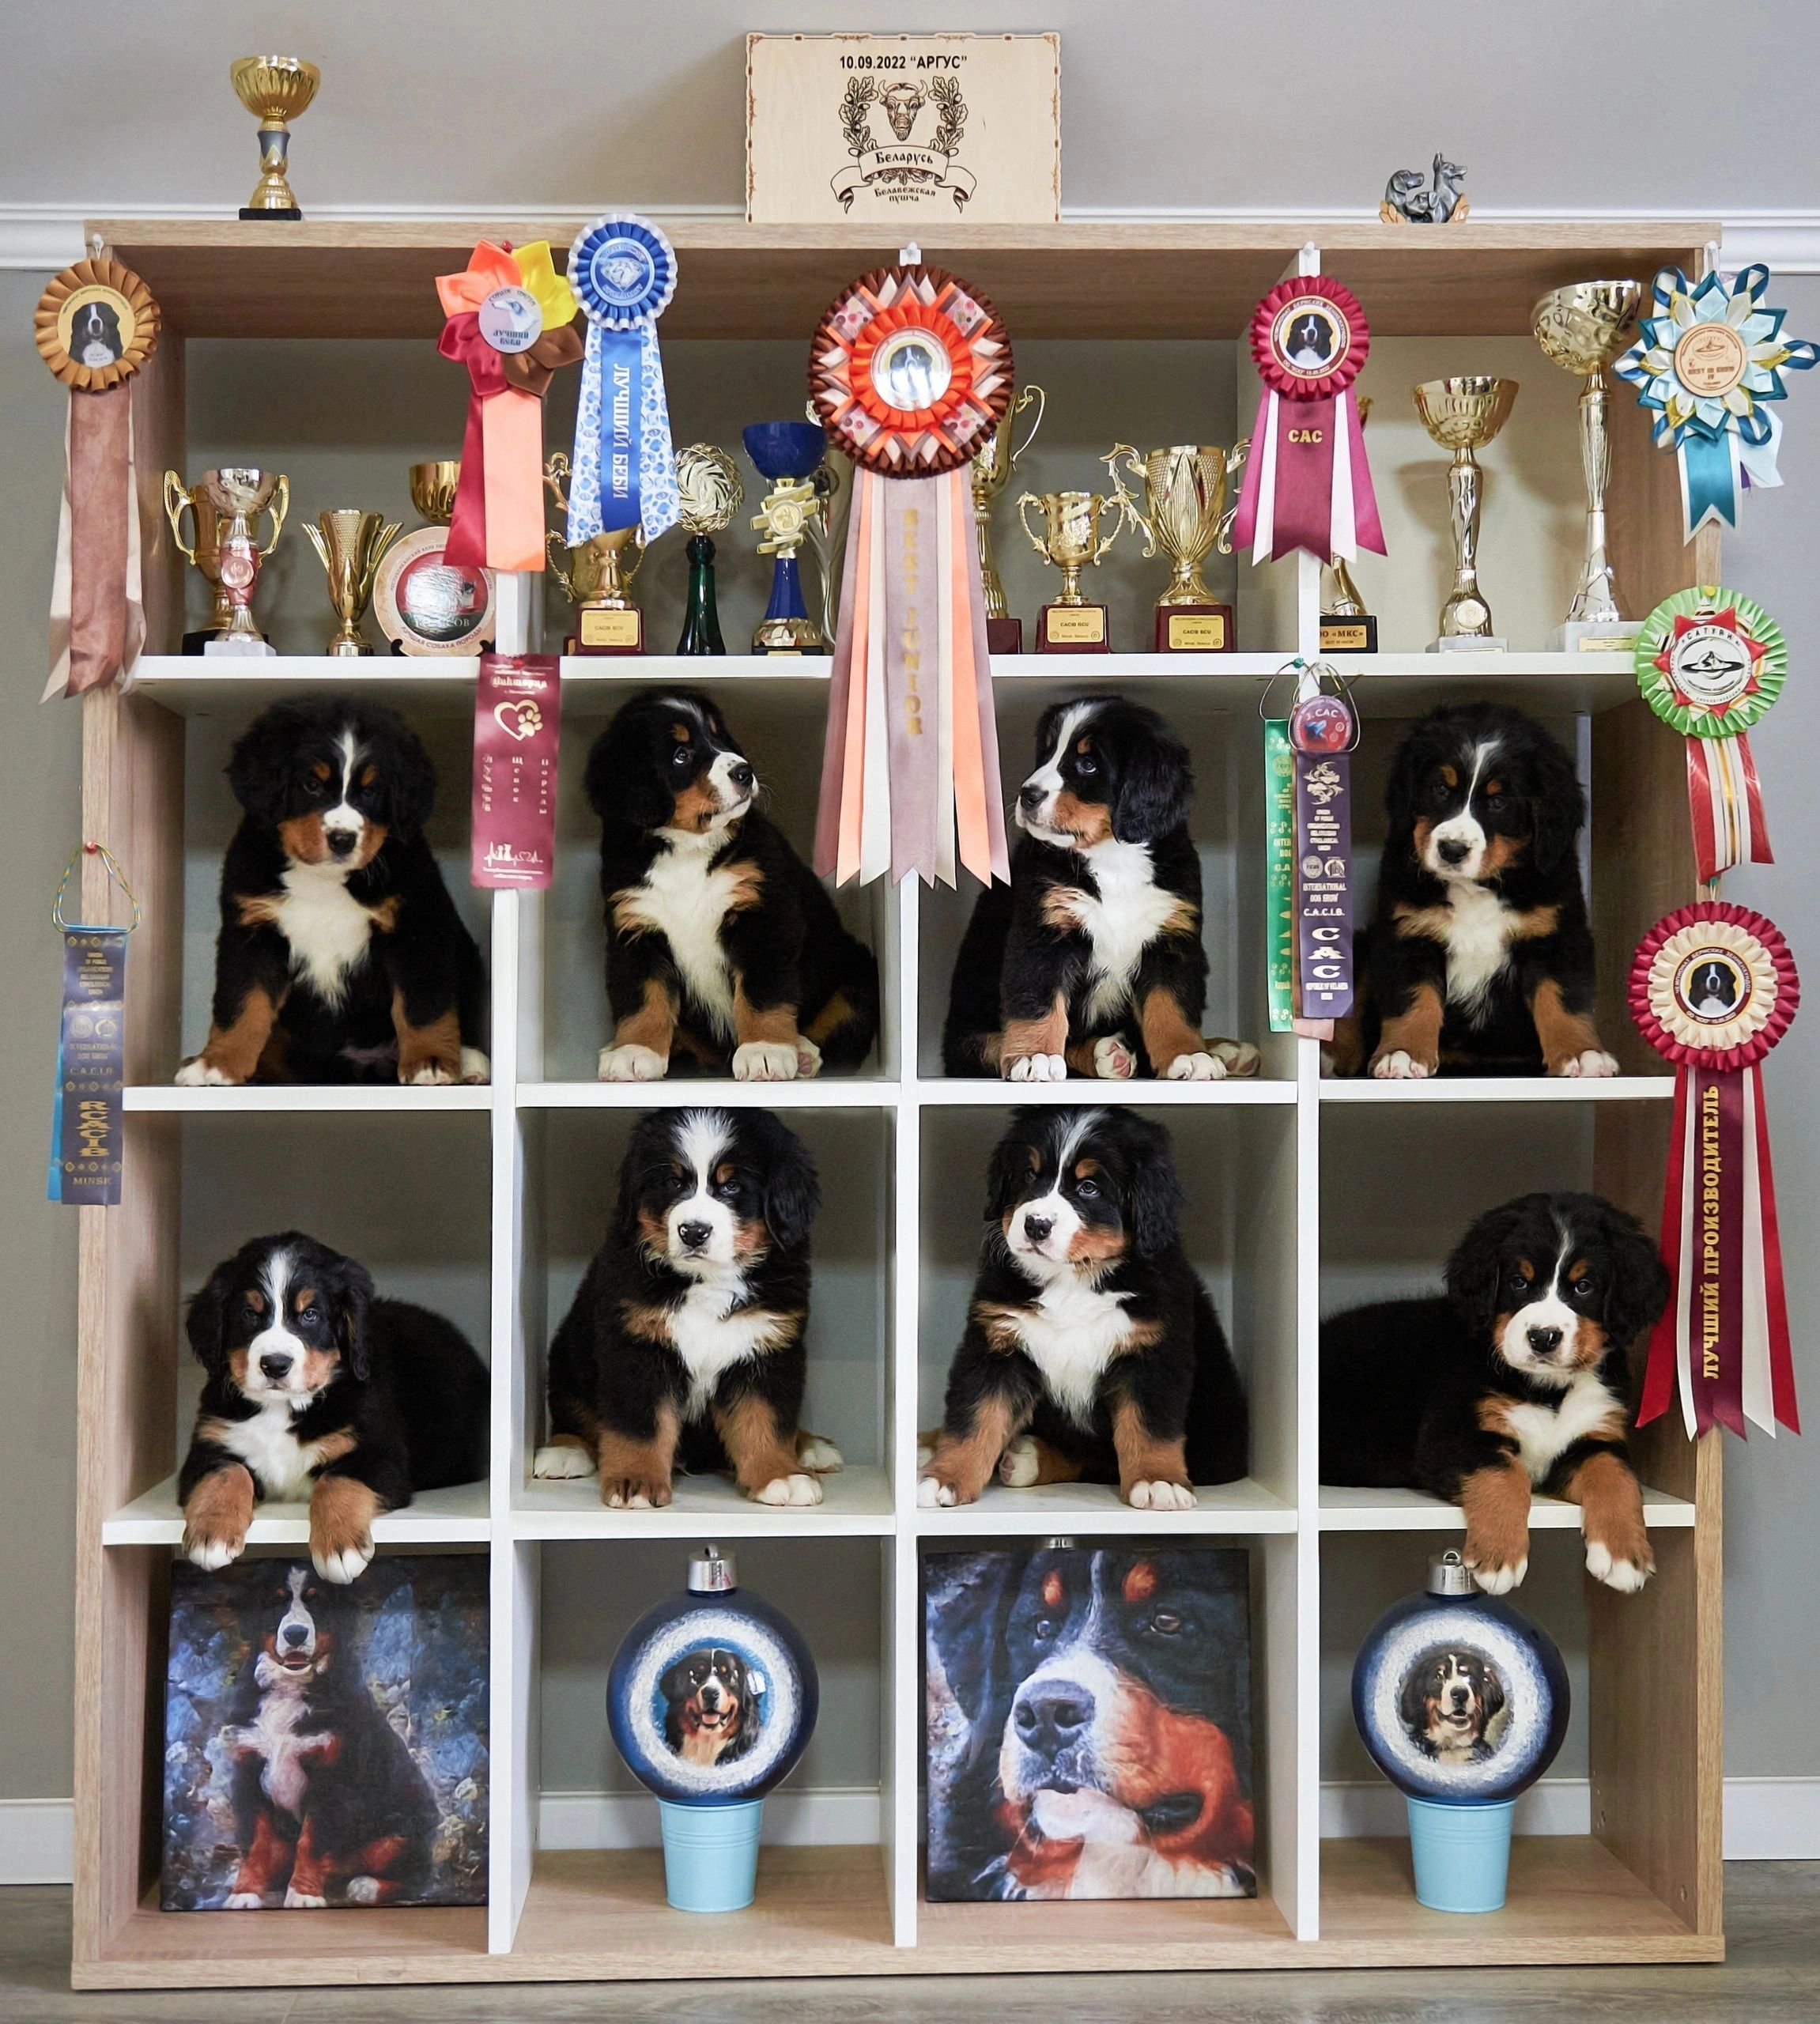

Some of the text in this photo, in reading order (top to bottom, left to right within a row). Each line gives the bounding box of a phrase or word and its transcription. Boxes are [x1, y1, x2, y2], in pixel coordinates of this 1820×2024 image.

[840, 55, 906, 69] 10.09.2022
[875, 151, 934, 165] Беларусь
[889, 194, 919, 204] пушча
[612, 363, 633, 499] ЛУЧШИЙ БЕБИ
[1288, 429, 1323, 444] CAC
[902, 508, 923, 735] BEST JUNIOR
[456, 626, 482, 647] ПОРОДЫ
[539, 758, 549, 814] Породы
[73, 1176, 111, 1185] MINSK
[1699, 1085, 1722, 1379] ЛУЧШИЙ ПРОИЗВОДИТЕЛЬ
